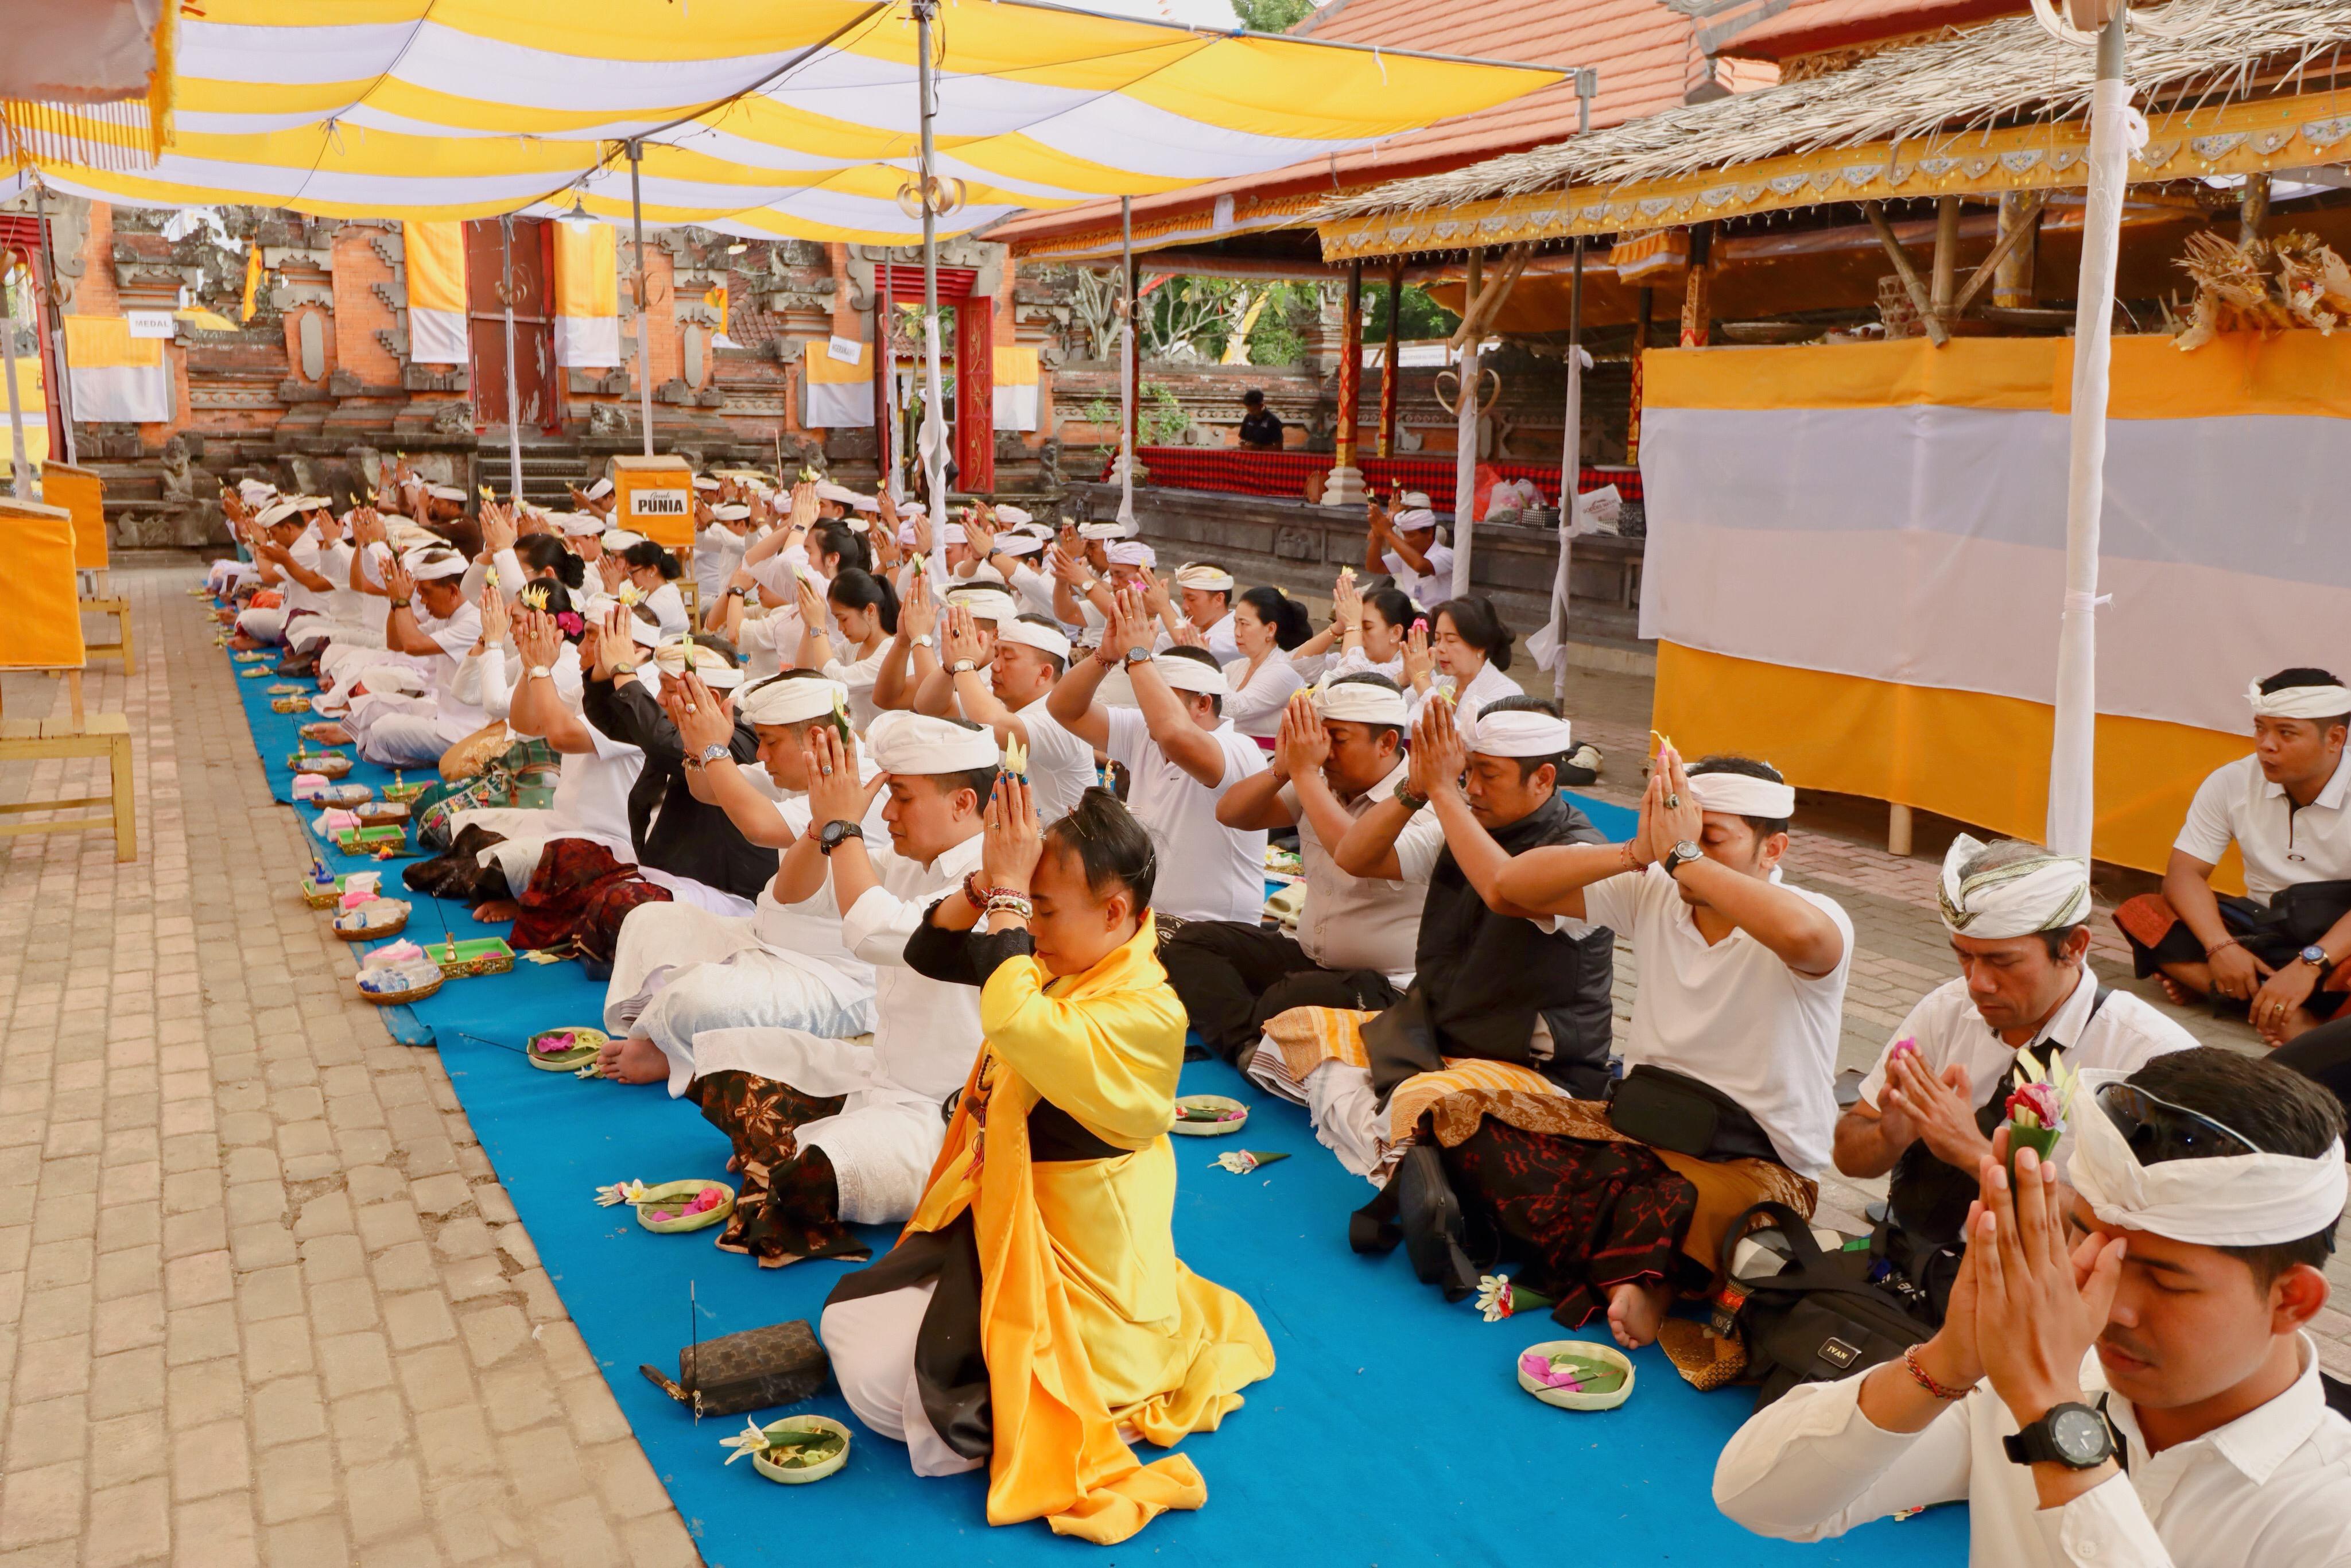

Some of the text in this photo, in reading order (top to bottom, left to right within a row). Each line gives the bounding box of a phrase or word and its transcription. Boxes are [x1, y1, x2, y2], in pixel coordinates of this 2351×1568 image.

[135, 320, 170, 328] MEDAL
[638, 499, 683, 513] PUNIA
[1826, 1345, 1848, 1360] IVAN
